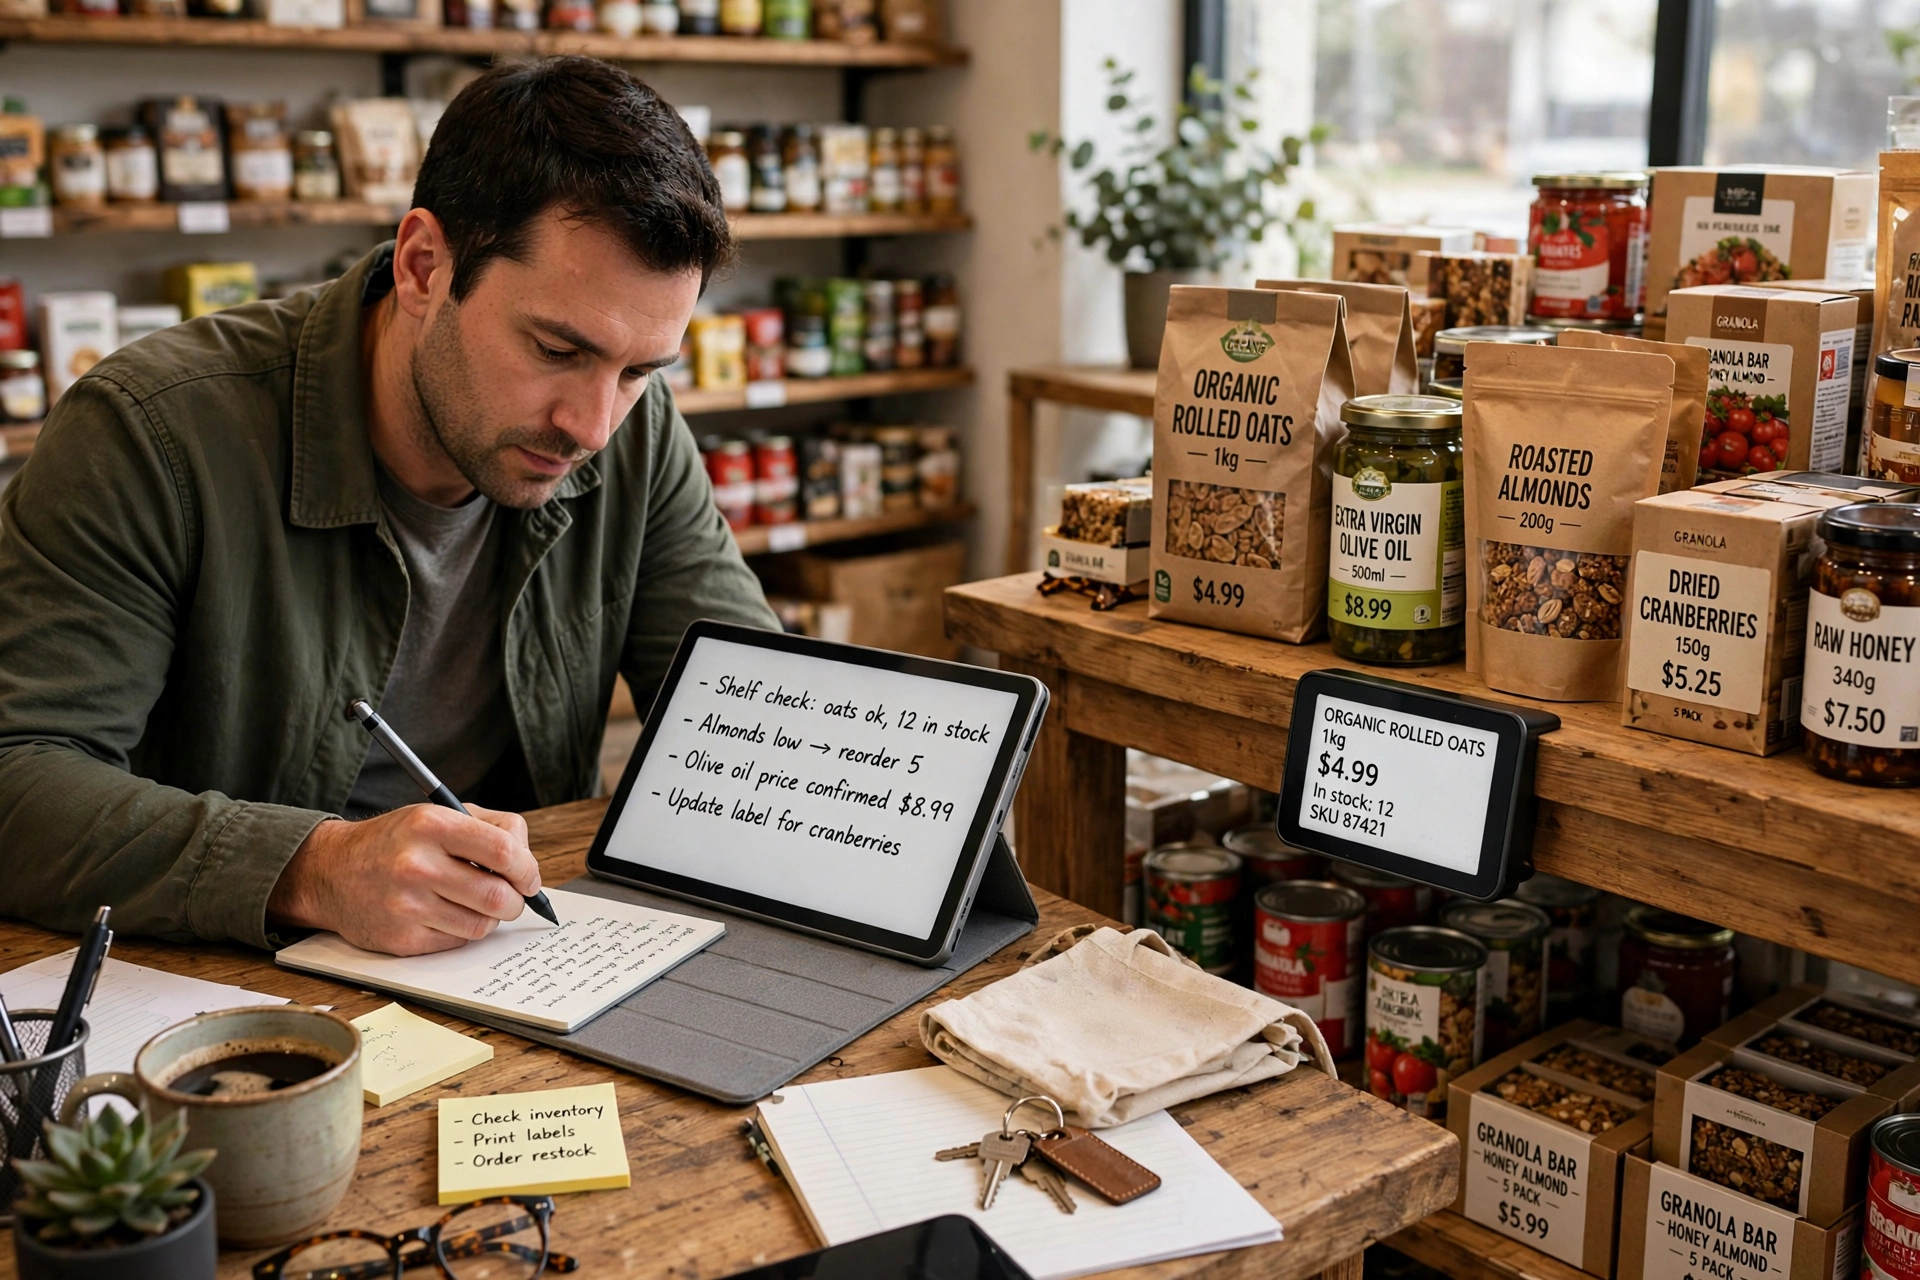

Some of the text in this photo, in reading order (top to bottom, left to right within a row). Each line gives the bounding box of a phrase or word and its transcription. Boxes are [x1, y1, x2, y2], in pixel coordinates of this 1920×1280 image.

[1747, 352, 1769, 369] BAR
[1194, 369, 1279, 405] ORGANIC
[1173, 404, 1293, 446] ROLLED OATS
[1215, 447, 1238, 472] 1kg
[1509, 444, 1593, 476] ROASTED
[1498, 475, 1592, 509] ALMONDS
[1336, 505, 1421, 535] EXTRA VIRGIN
[1520, 512, 1553, 534] 200g
[1340, 533, 1412, 561] OLIVE OIL
[1674, 531, 1726, 549] GRANOLA
[1352, 565, 1385, 582] 500ml
[1669, 569, 1719, 600] DRIED
[1193, 576, 1245, 609] $4.99
[1345, 592, 1391, 620] $8.99
[1640, 596, 1757, 639] CRANBERRIES
[1676, 636, 1710, 662] 150g
[1814, 621, 1916, 663] RAW HONEY
[1662, 660, 1721, 697] $5.25
[1832, 666, 1875, 695] 340g
[716, 675, 990, 744] Shelf check: oats ok, 12 in stock
[1824, 697, 1885, 734] $7.50
[699, 713, 923, 774] Almonds low reorder 5
[1323, 728, 1346, 750] 1kg
[1324, 707, 1486, 757] ORGANIC ROLLED OATS
[1318, 751, 1379, 786] $4.99
[685, 751, 953, 822] Olive oil price confirmed $8.99
[1313, 783, 1394, 817] In stock: 12
[669, 787, 901, 856] Update label for cranberries
[1310, 804, 1386, 837] SKU 87421
[472, 1105, 603, 1125] Check inventory
[474, 1125, 575, 1147] Print labels
[1478, 1122, 1576, 1180] GRANOLA BAR
[473, 1143, 596, 1167] Order restock
[1484, 1149, 1568, 1196] HONEY ALMOND
[1503, 1179, 1540, 1206] 5 PACK
[1498, 1201, 1549, 1239] $5.99
[1661, 1191, 1777, 1255] GRANOLA BAR
[1668, 1219, 1767, 1272] HONEY ALMOND
[1689, 1252, 1734, 1280] 5 PACK
